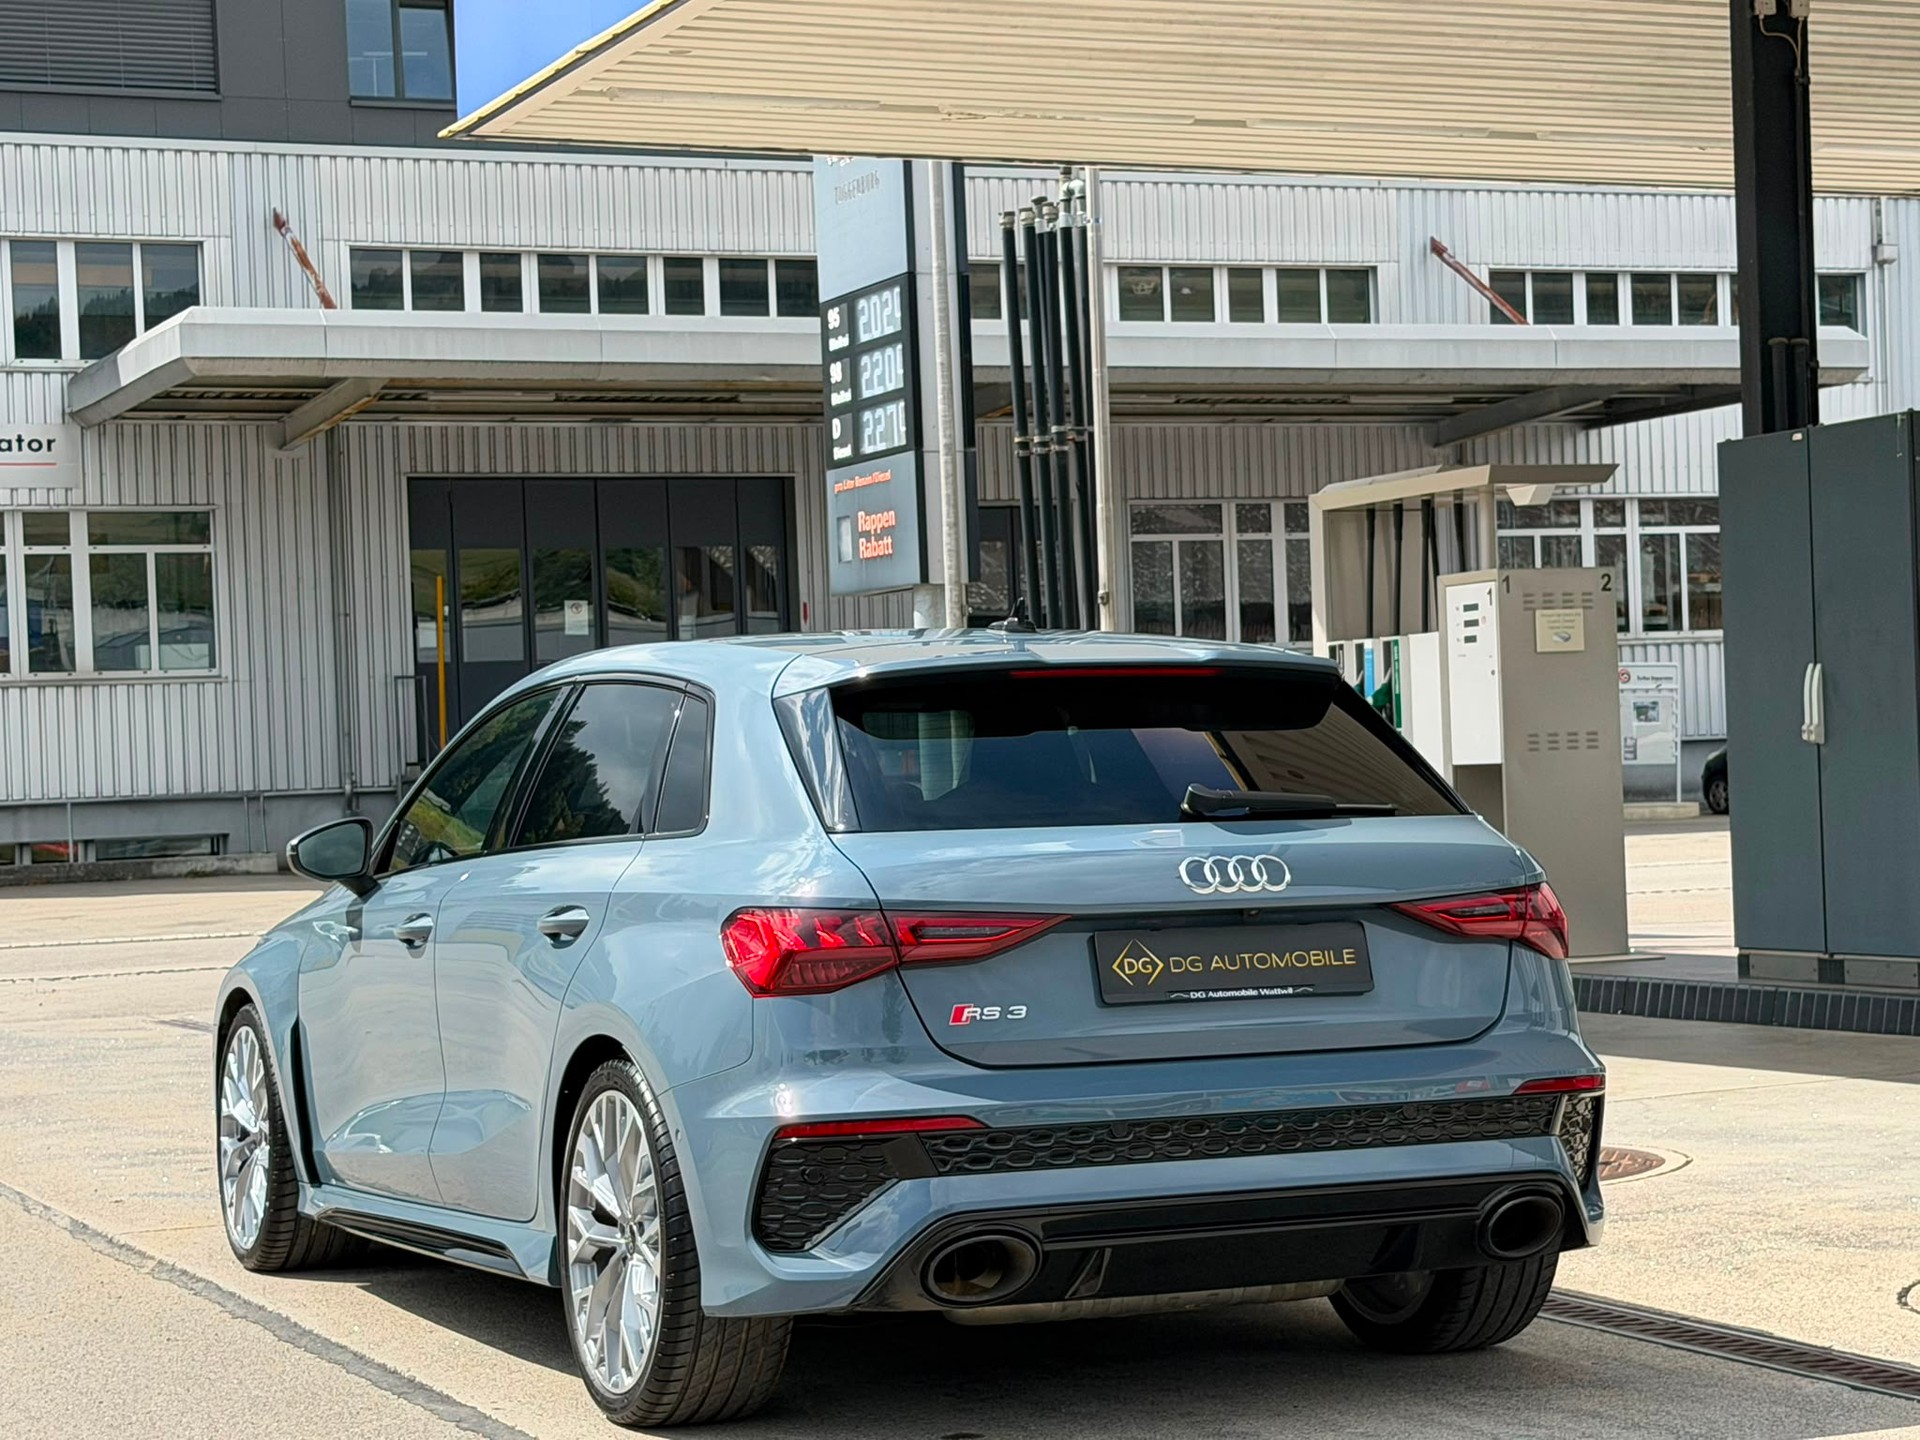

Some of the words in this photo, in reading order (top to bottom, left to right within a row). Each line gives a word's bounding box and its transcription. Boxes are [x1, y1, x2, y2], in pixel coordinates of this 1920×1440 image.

[828, 307, 840, 330] 95
[832, 418, 841, 440] D
[0, 433, 56, 453] ator
[857, 510, 896, 535] Rappen
[859, 535, 893, 559] Rabatt
[1502, 575, 1510, 594] 1
[1601, 573, 1612, 592] 2
[1486, 587, 1493, 606] 1
[1124, 957, 1152, 974] DG
[1169, 956, 1203, 973] DG
[1210, 948, 1357, 972] AUTOMOBILE
[1190, 991, 1206, 999] DG
[1208, 988, 1258, 998] Automobile
[1259, 987, 1293, 996] Wattwil
[958, 1005, 1001, 1022] RS
[1007, 1005, 1027, 1019] 3
